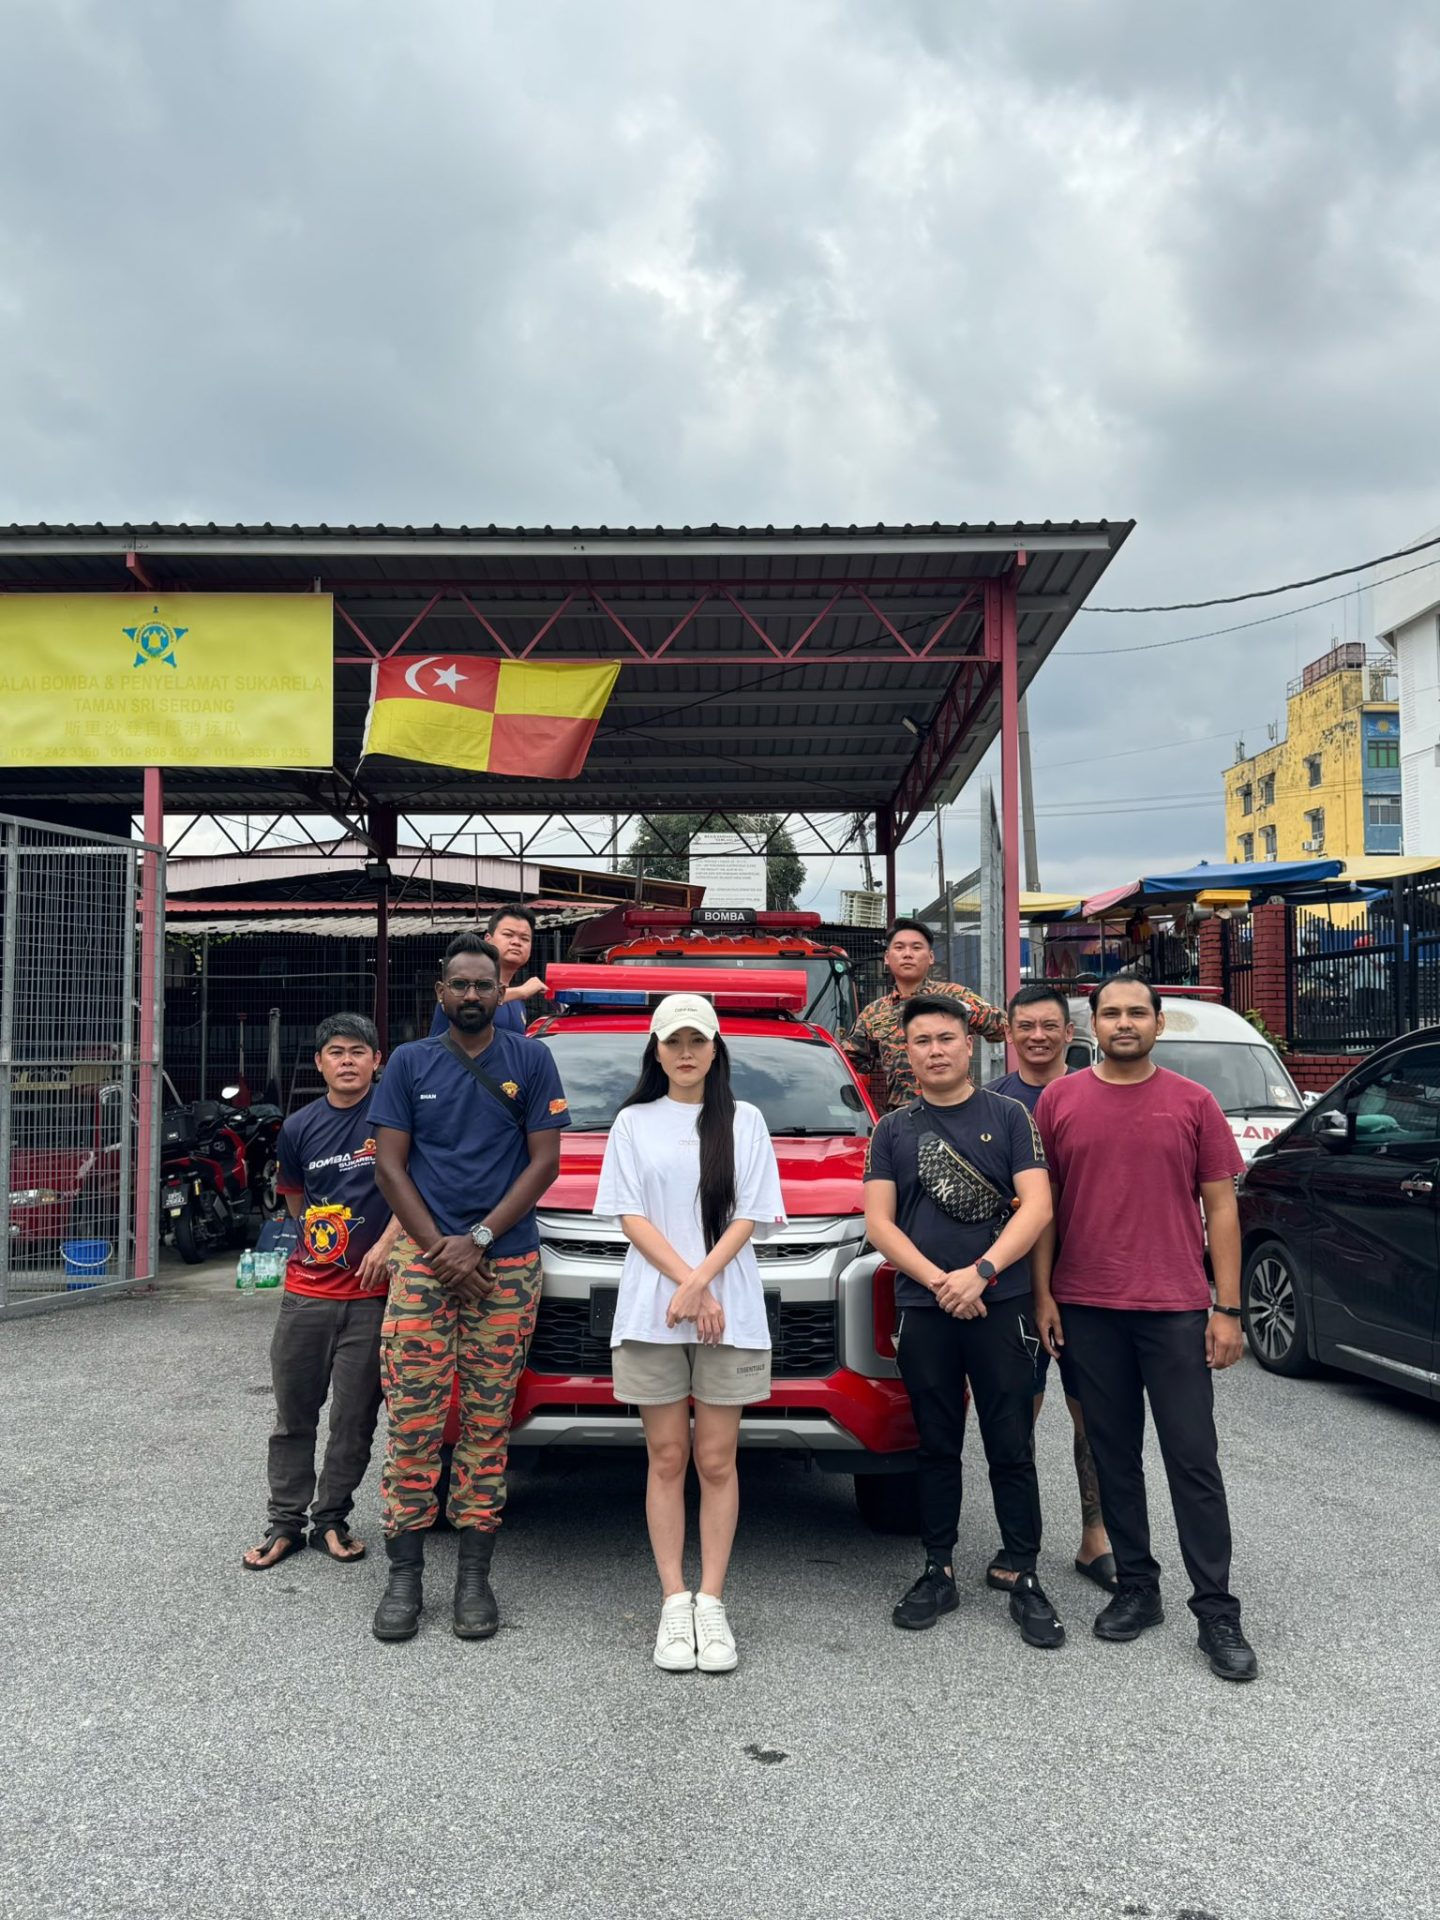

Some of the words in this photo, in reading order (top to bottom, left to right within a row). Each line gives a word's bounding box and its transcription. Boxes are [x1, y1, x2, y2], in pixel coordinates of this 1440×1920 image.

[41, 674, 99, 691] BOMBA
[104, 674, 115, 690] &
[121, 674, 230, 691] PENYELAMAT
[234, 674, 324, 691] SUKARELA
[73, 698, 127, 713] TAMAN
[131, 698, 155, 713] SRI
[159, 698, 235, 713] SERDANG
[704, 911, 745, 921] BOMBA
[309, 1152, 352, 1170] BOMBA
